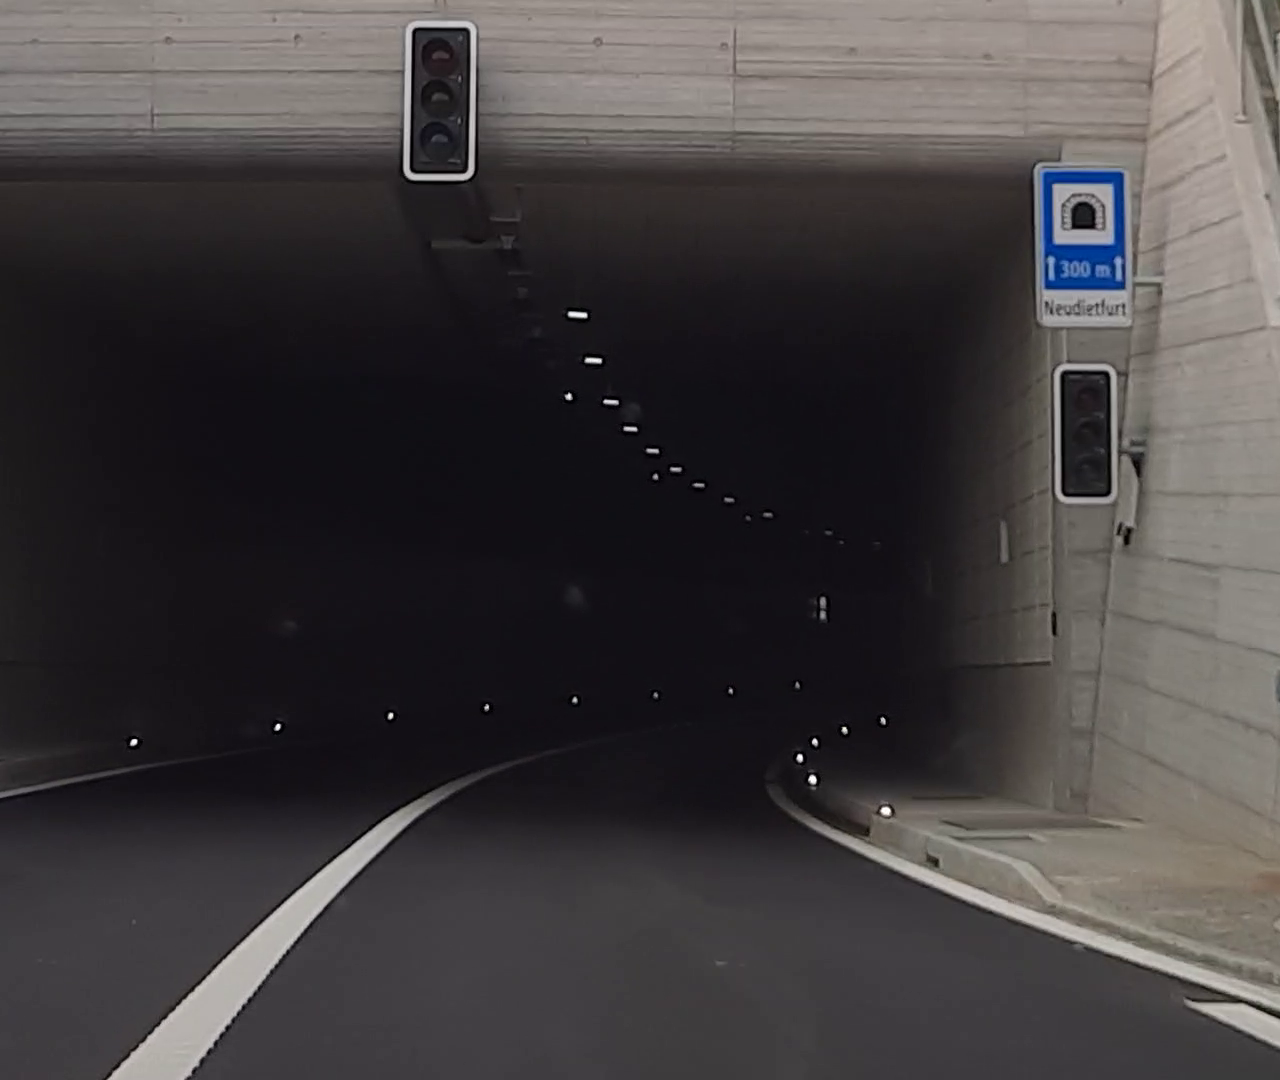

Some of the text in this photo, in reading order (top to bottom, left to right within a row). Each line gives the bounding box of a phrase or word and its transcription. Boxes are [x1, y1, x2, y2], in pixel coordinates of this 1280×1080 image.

[1060, 260, 1112, 278] 300 m
[1044, 299, 1126, 316] Neudietfurt
